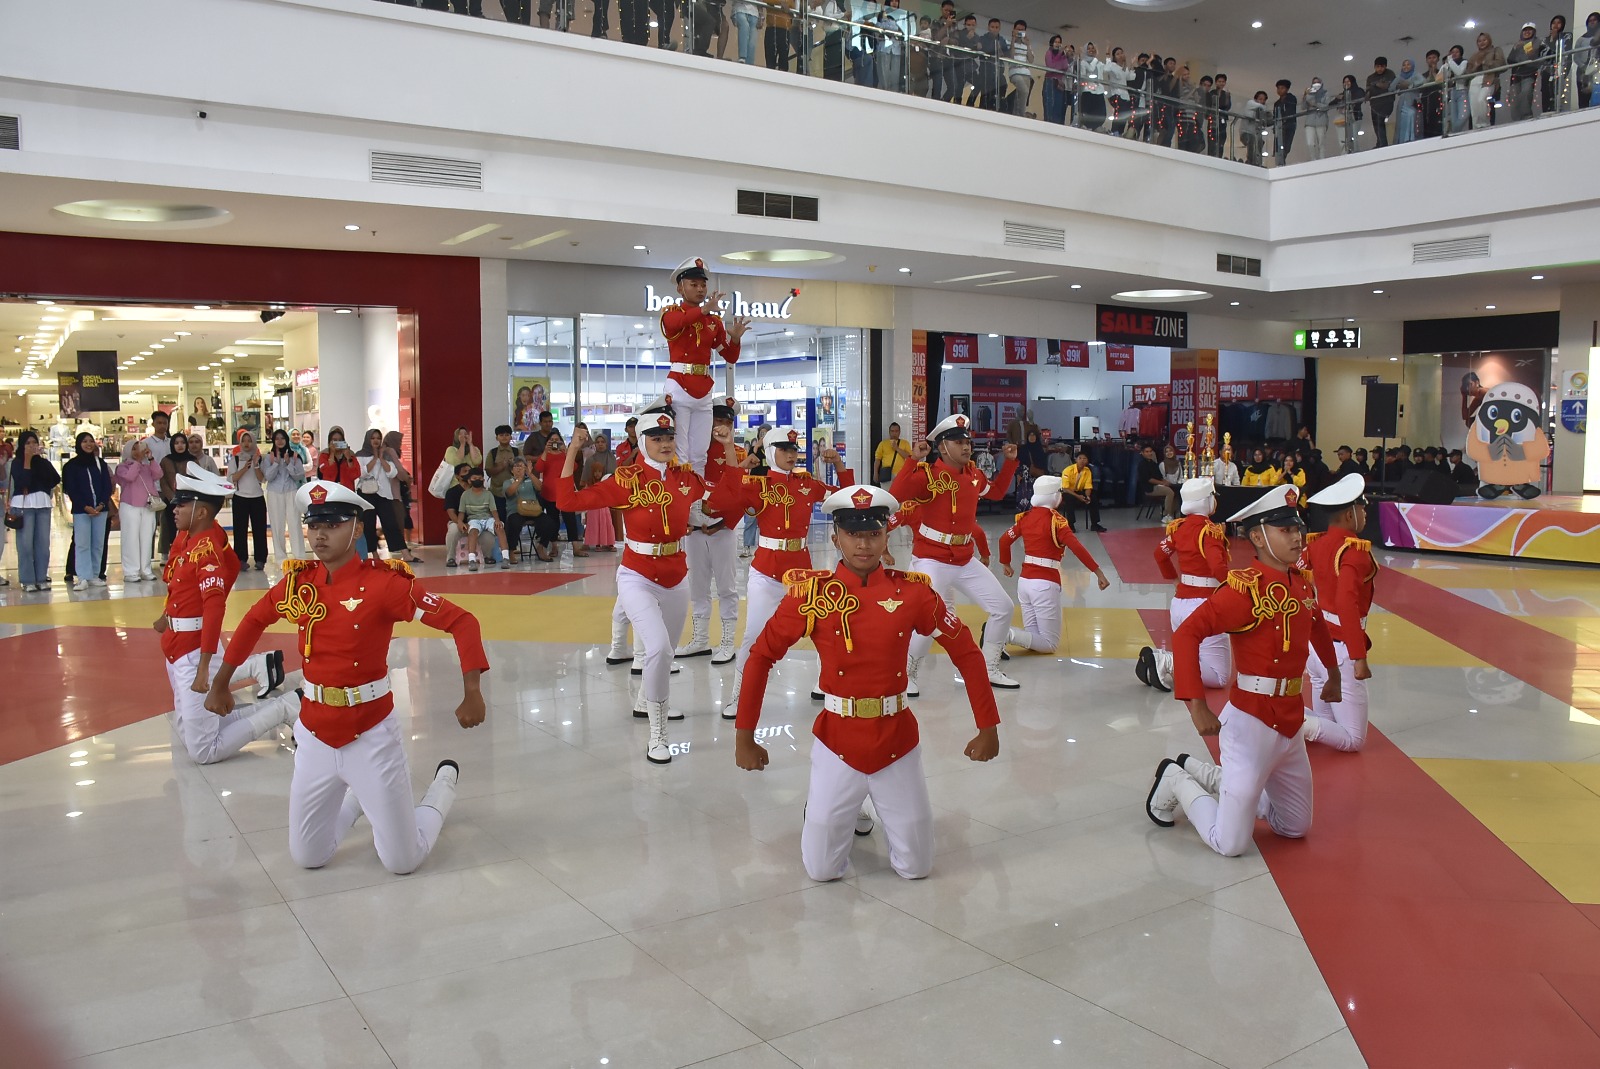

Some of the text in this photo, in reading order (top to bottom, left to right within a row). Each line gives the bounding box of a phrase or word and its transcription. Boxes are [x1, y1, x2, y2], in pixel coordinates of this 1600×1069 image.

[733, 289, 796, 319] haul
[1101, 310, 1184, 338] SALE ZONE
[952, 344, 969, 358] 99K
[1066, 349, 1081, 362] 99K
[912, 352, 926, 367] BIG
[912, 366, 926, 376] SALE
[1172, 379, 1195, 395] BEST
[1198, 376, 1217, 394] BIG
[1231, 384, 1248, 398] 99K
[1172, 395, 1195, 410] DEAL
[1198, 394, 1217, 409] SALE
[1172, 410, 1195, 425] EVER
